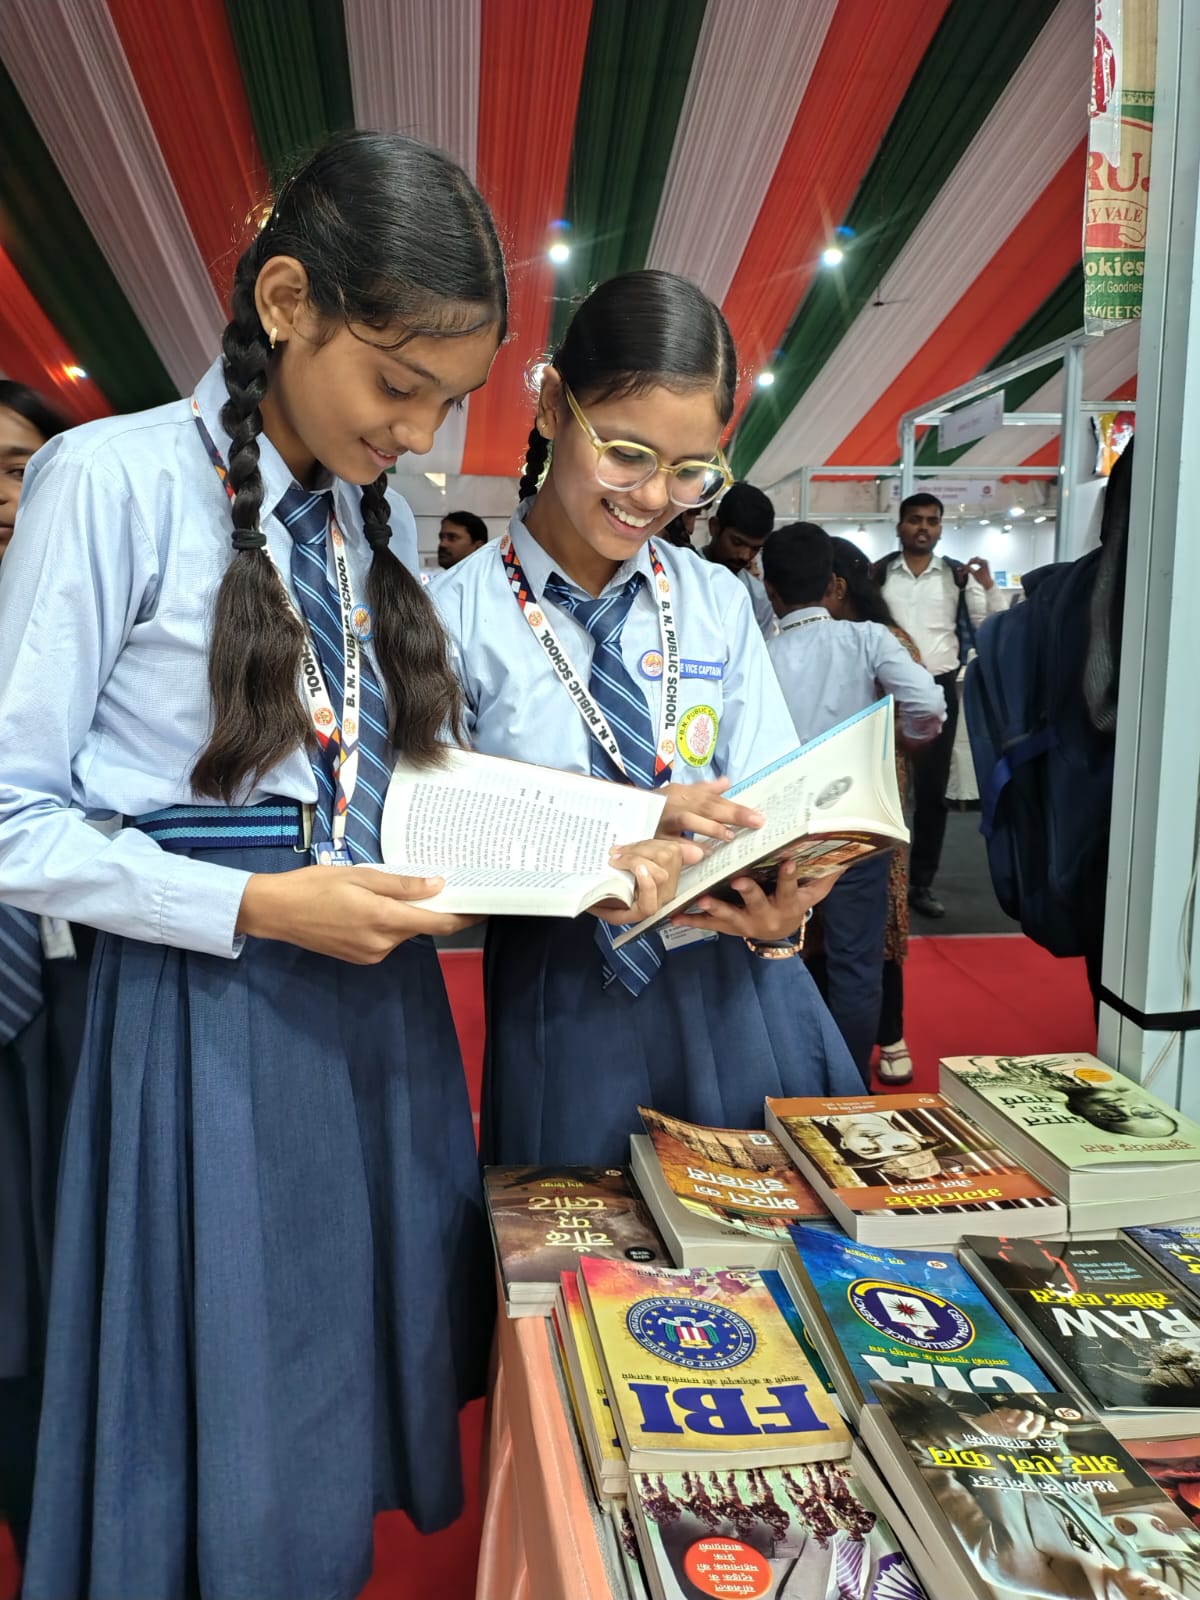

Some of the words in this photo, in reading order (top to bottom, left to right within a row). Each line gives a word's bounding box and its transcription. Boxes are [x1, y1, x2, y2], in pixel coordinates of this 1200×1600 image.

[1105, 207, 1143, 223] VALE
[337, 556, 352, 611] SCHOOL
[661, 600, 671, 612] B.
[663, 614, 673, 627] N.
[540, 629, 574, 681] SCHOOL
[665, 629, 678, 674] PUBLIC
[301, 645, 322, 698] HOOL
[685, 663, 698, 674] VICE
[698, 664, 722, 676] CAPTAIN
[347, 674, 356, 690] N.
[346, 694, 356, 708] B.
[568, 680, 602, 726] PUBLIC
[664, 677, 677, 730] SCHOOL
[598, 725, 610, 740] N.
[608, 741, 618, 755] B.
[1027, 1105, 1055, 1113] का
[1021, 1114, 1086, 1127] भारत
[1081, 1143, 1115, 1154] बोस
[687, 1167, 787, 1193] इतिहास
[891, 1181, 938, 1194] डायरी
[693, 1184, 723, 1198] का
[884, 1187, 1002, 1207] भगतसिंह
[528, 1196, 607, 1213] प्लॉट
[728, 1191, 799, 1210] भारत
[556, 1215, 592, 1228] पर
[545, 1230, 614, 1252] चाँद
[683, 1300, 722, 1315] BUREAU
[852, 1295, 882, 1327] AGENCY
[628, 1298, 665, 1334] INVESTIGATION
[723, 1310, 750, 1338] FEDERAL
[1051, 1307, 1200, 1338] RAW
[884, 1327, 960, 1349] INTELLIGENCE
[641, 1336, 677, 1362] JUSTICE
[698, 1342, 750, 1368] DEPARTMENT
[701, 1377, 717, 1386] और
[628, 1383, 830, 1435] FBI
[1033, 1438, 1060, 1452] की
[927, 1446, 995, 1470] काव
[1036, 1480, 1060, 1496] के
[1063, 1480, 1118, 1493] R&AW
[697, 1542, 744, 1552] बायोग्राफी
[713, 1552, 736, 1562] प्रेरक
[696, 1563, 711, 1573] की
[713, 1562, 759, 1571] महानायक
[708, 1573, 720, 1583] के
[714, 1583, 755, 1593] सर्जिकल
